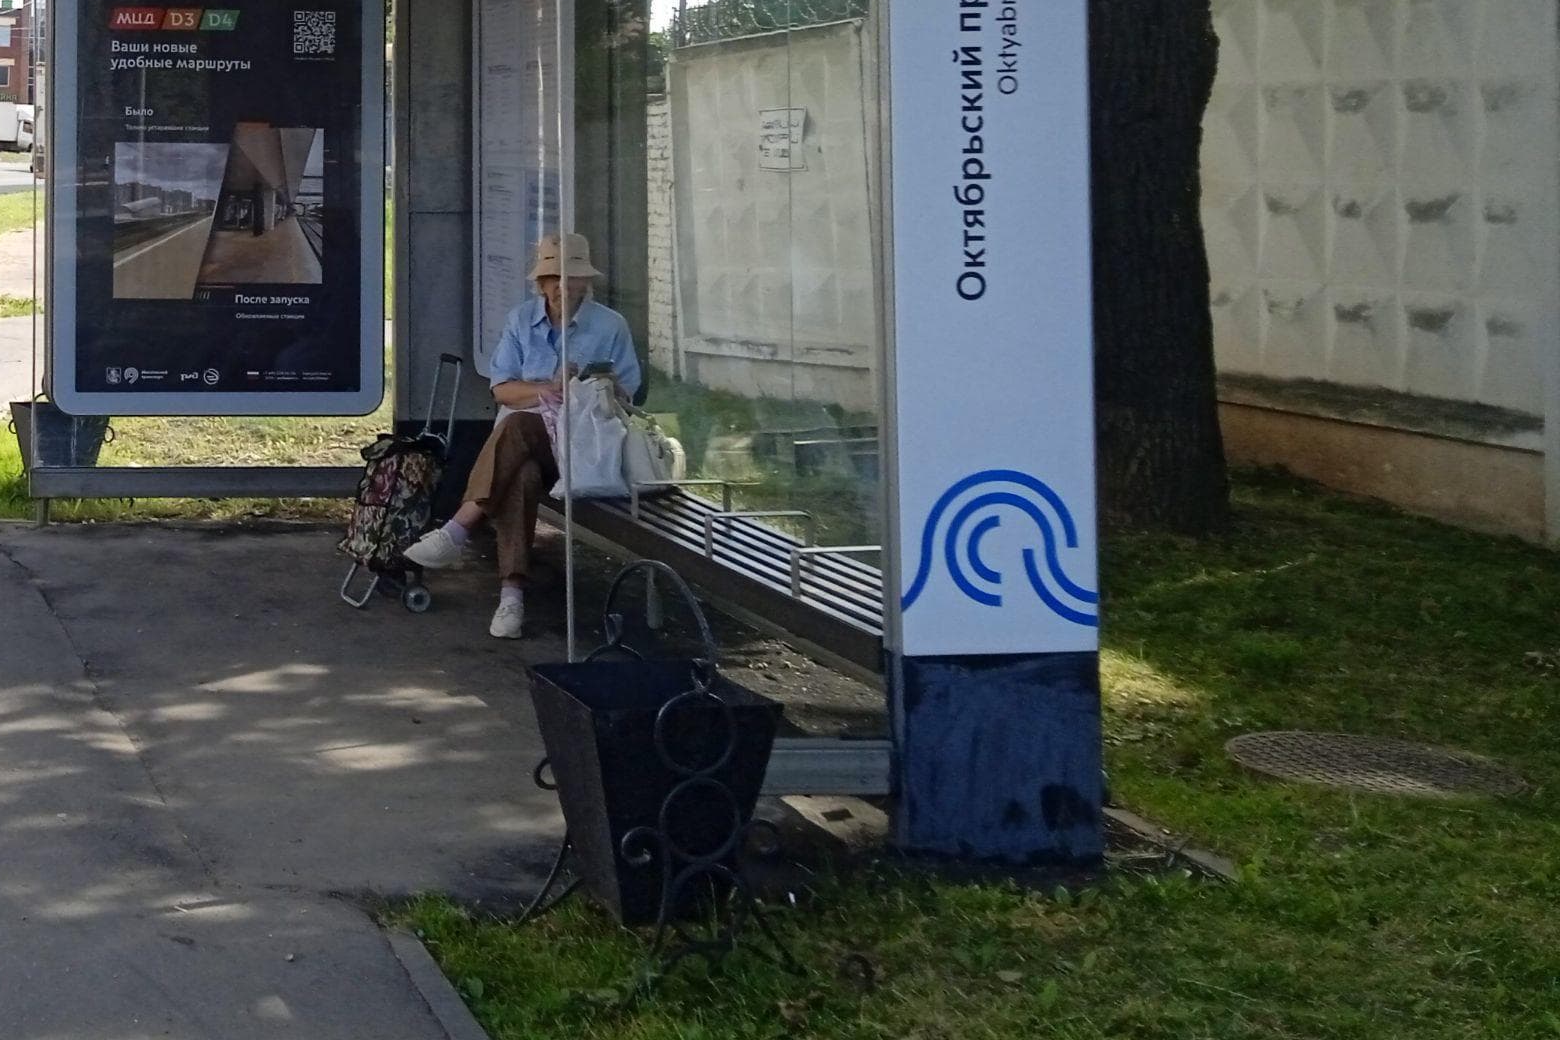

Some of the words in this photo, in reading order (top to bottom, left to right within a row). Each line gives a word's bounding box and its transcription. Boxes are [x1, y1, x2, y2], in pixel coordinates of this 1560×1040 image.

[116, 12, 156, 25] МЦД
[170, 12, 196, 27] D3
[208, 13, 234, 27] D4
[111, 40, 150, 53] Ваши
[153, 43, 198, 54] новые
[110, 56, 173, 71] удобные
[176, 58, 251, 72] маршруты
[125, 106, 154, 117] Было
[952, 46, 992, 301] Октябрьский
[235, 294, 268, 304] После
[270, 296, 310, 306] запуска
